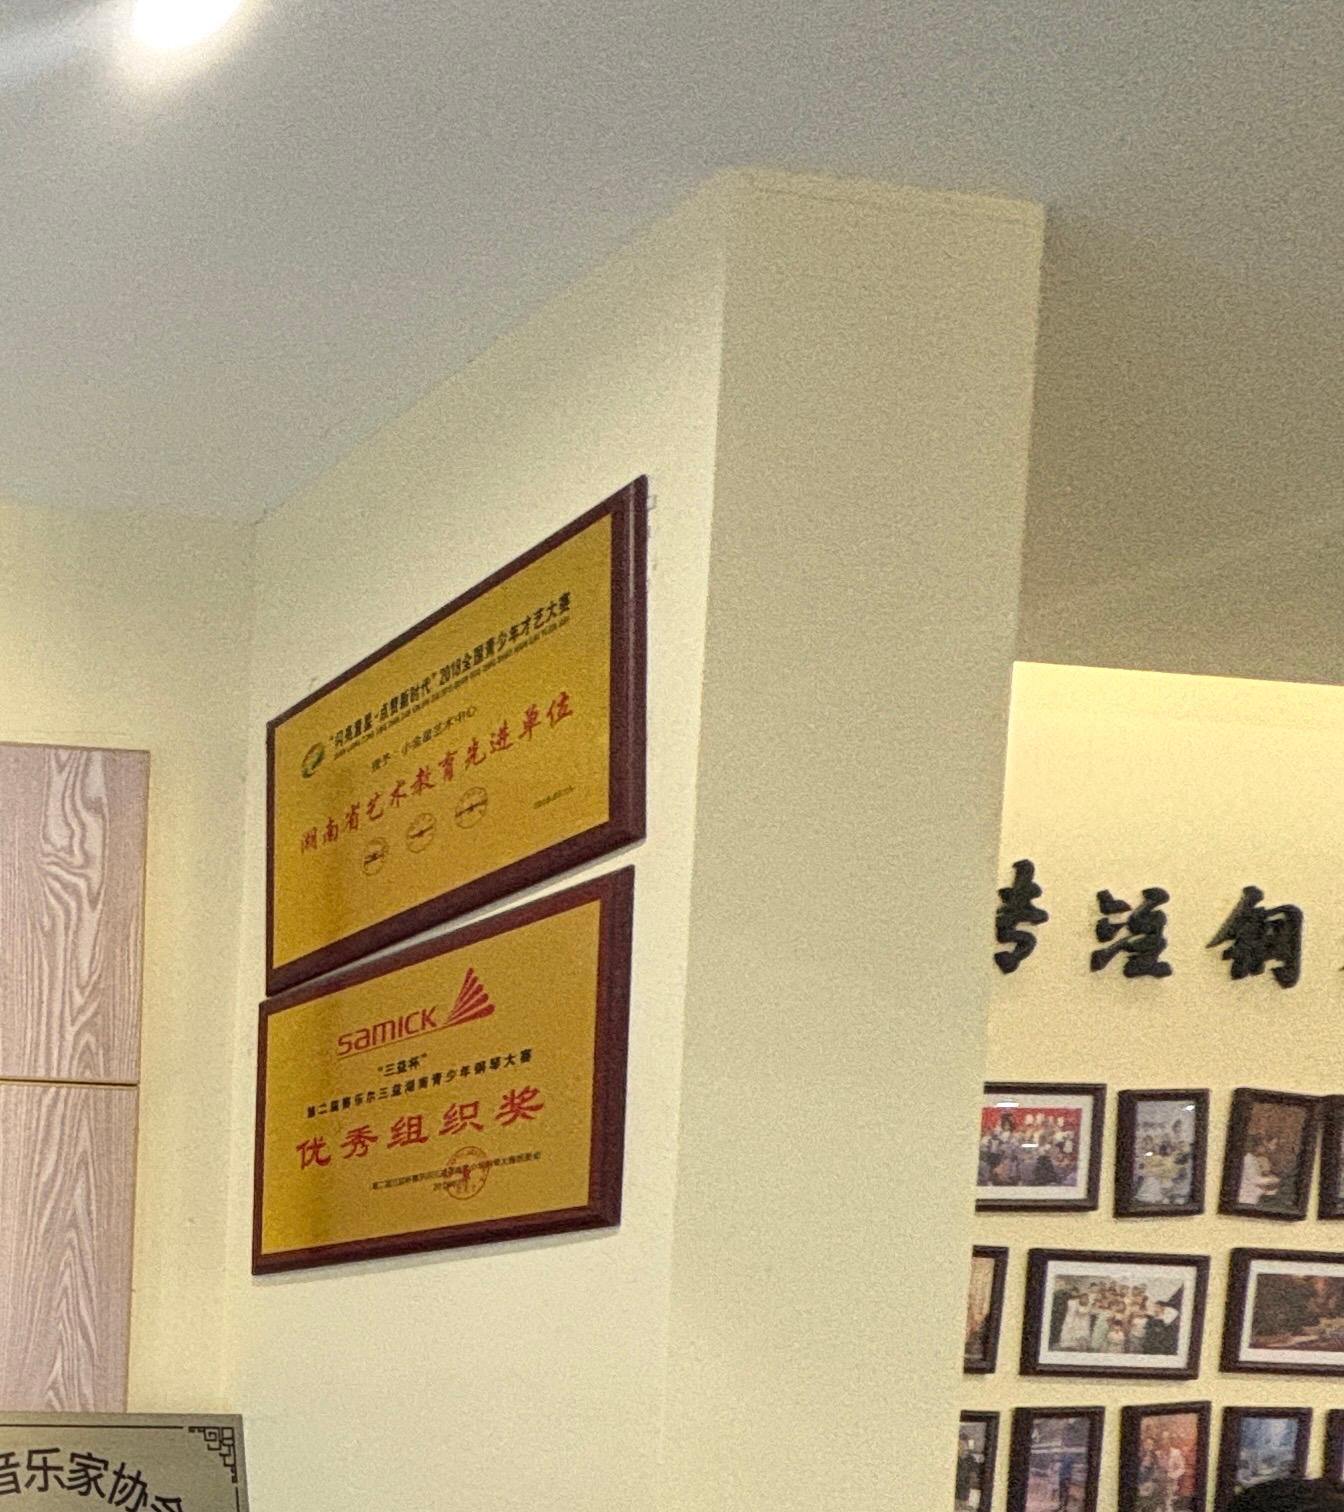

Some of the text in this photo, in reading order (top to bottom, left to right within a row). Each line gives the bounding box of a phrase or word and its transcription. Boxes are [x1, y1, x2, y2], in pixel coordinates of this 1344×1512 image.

[301, 691, 573, 853] 湖南省艺术教育先进单位
[296, 1085, 545, 1170] 优秀组织奖
